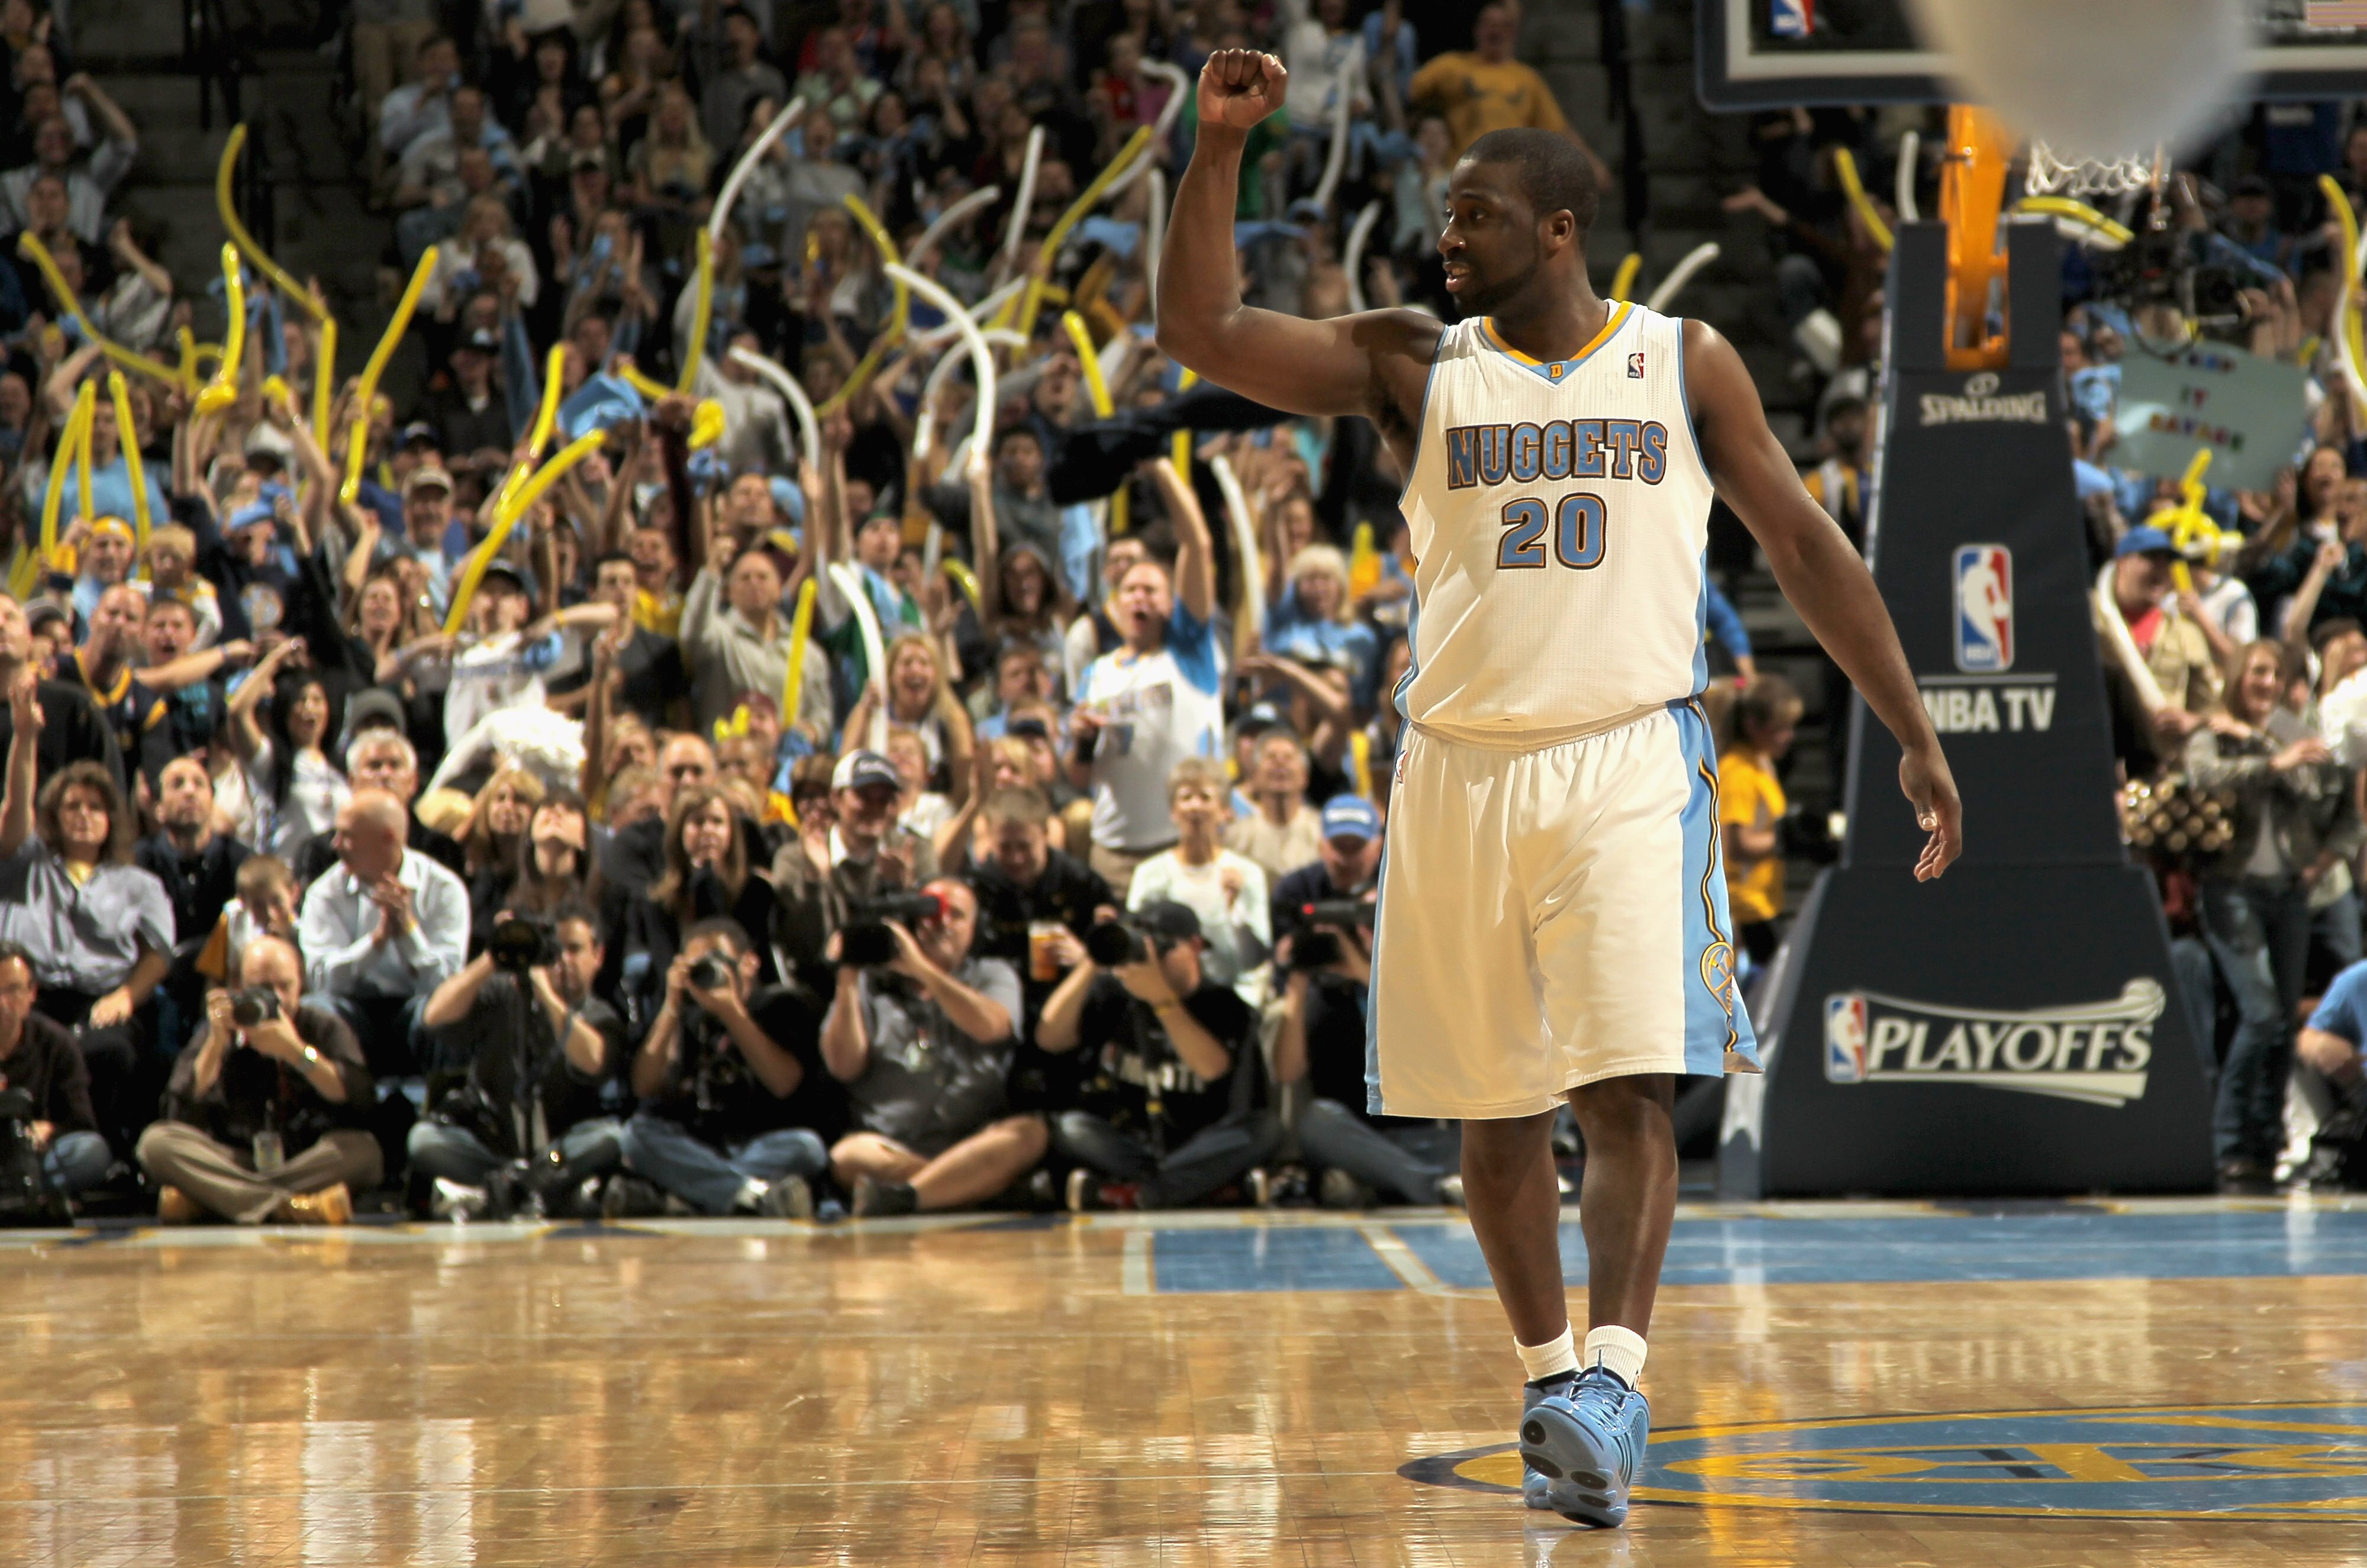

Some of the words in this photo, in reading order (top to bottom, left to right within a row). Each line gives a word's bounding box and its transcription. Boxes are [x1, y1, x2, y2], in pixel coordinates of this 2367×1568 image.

[1550, 363, 1563, 378] D
[1920, 390, 2047, 426] SPALDING
[1446, 418, 1668, 490] NUGGETS
[1497, 492, 1607, 570] 20
[1923, 688, 2000, 733] NBA
[2002, 686, 2056, 731] TV
[1866, 1017, 2153, 1072] PLAYOFFS
